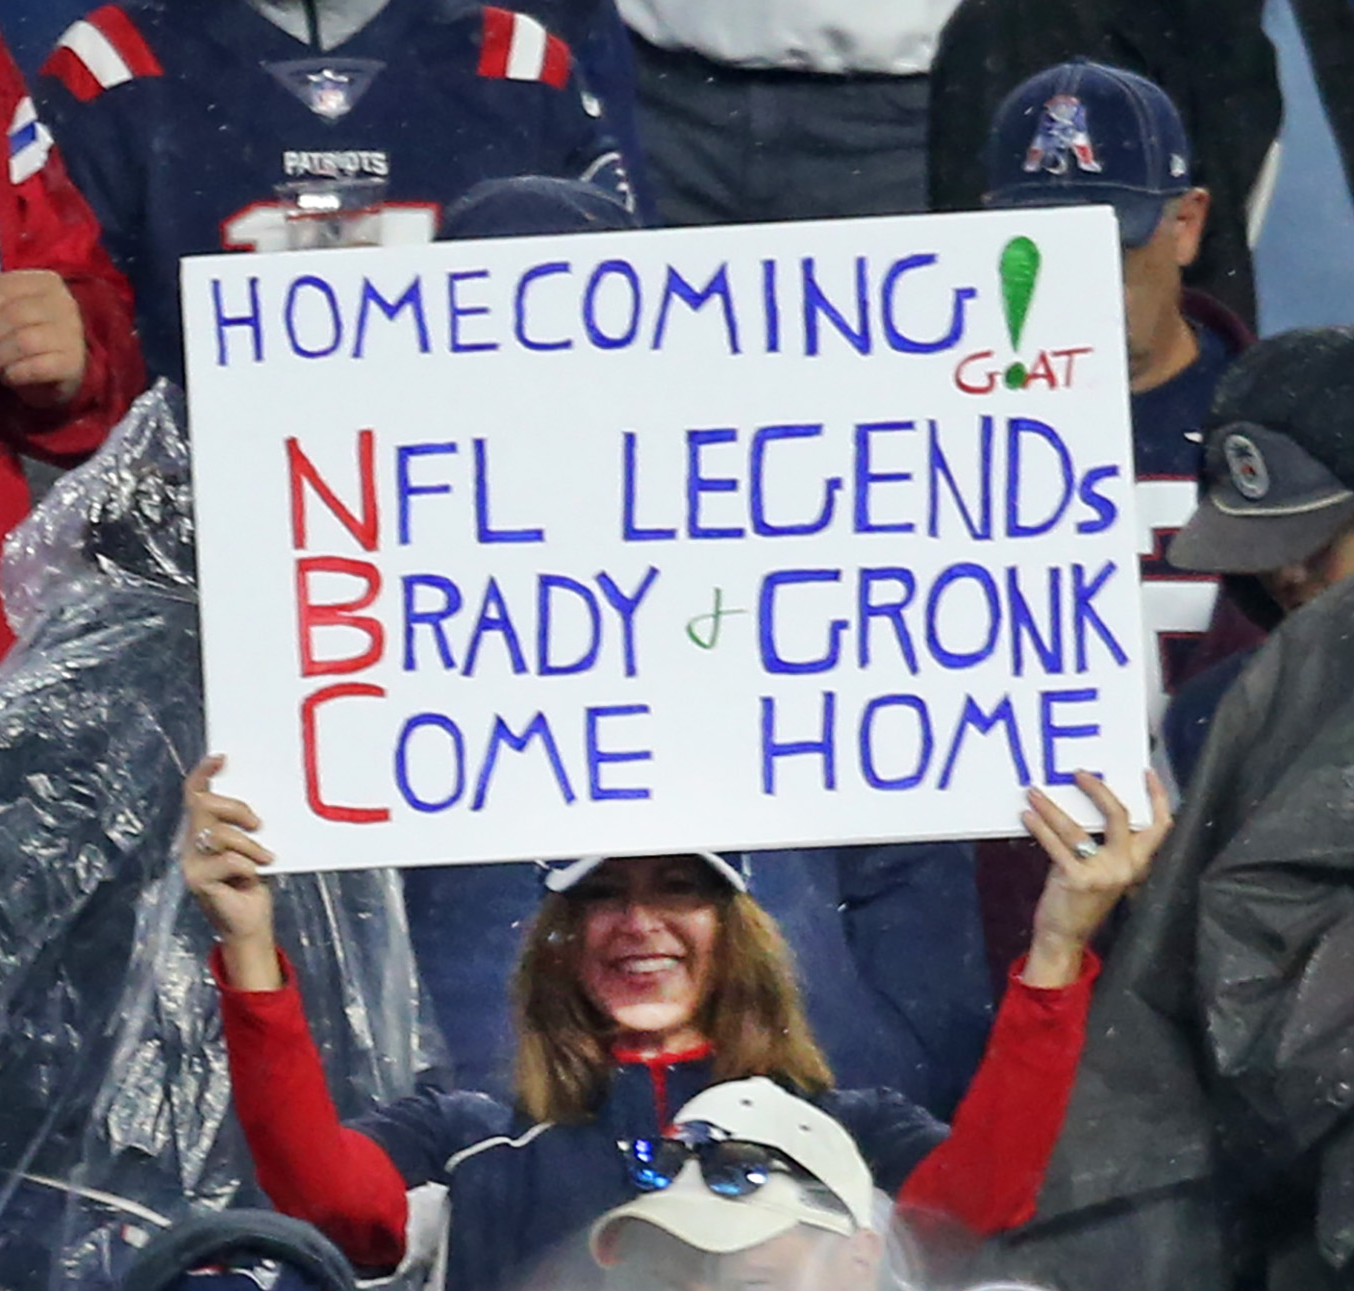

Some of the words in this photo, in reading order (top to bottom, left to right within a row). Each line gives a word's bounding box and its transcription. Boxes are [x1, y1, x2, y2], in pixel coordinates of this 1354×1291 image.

[282, 150, 389, 176] PATRIOTS
[286, 428, 545, 551] NFL
[294, 555, 660, 677] BRADY
[757, 560, 1129, 676] GRONK
[299, 681, 653, 823] COME
[760, 688, 1104, 796] HOME
